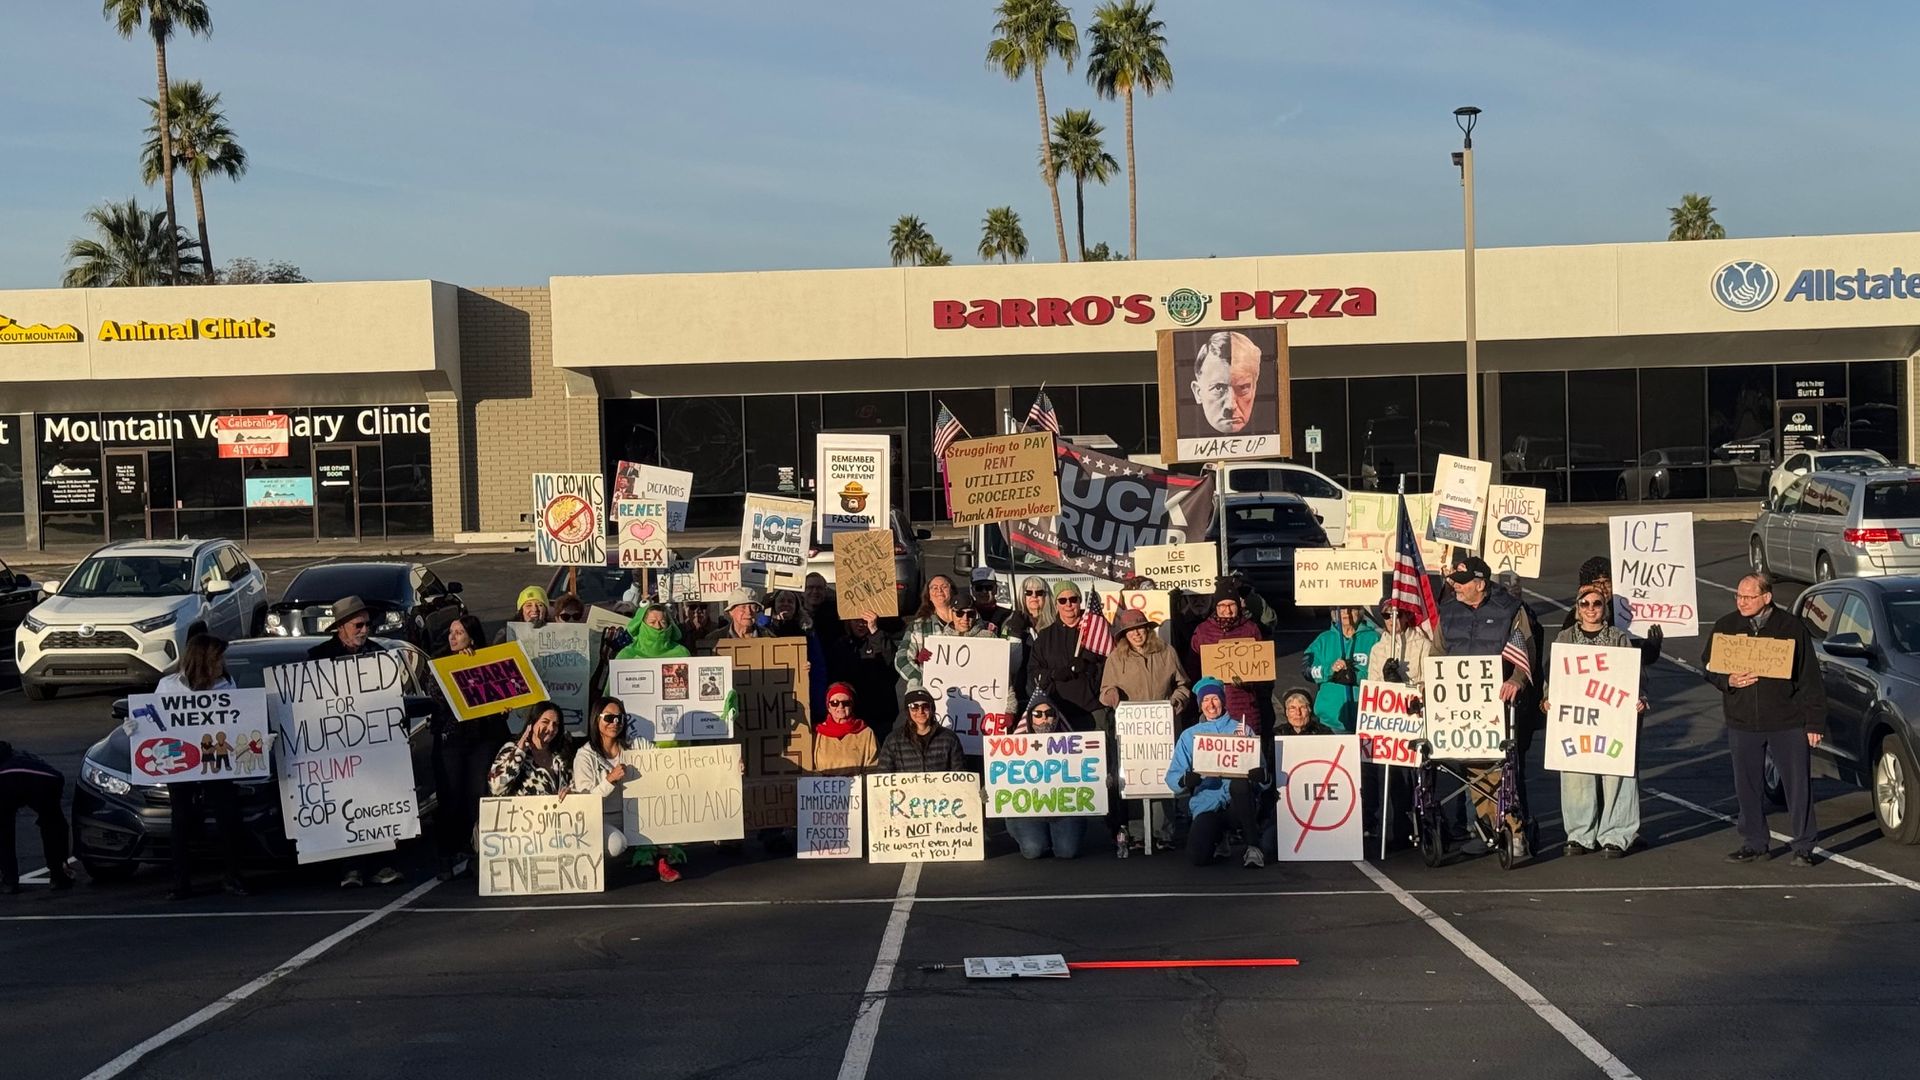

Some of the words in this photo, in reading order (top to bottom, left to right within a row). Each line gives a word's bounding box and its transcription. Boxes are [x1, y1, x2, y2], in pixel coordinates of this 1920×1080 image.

[1784, 267, 1920, 302] Allstate
[1220, 287, 1378, 321] PIZZA
[25, 332, 75, 341] MOUNTAIN
[98, 318, 198, 341] Animal
[199, 317, 276, 340] Clinic
[44, 413, 183, 443] Mountain
[358, 407, 430, 436] Clinic
[228, 417, 278, 429] Celebrating
[233, 446, 243, 454] 41
[246, 444, 275, 454] Years!
[947, 442, 1006, 459] Struggling
[1009, 441, 1020, 451] to
[1024, 436, 1048, 450] PAY
[1194, 439, 1241, 456] WAKE
[1245, 437, 1267, 454] UP
[832, 455, 875, 463] REMEMBER
[832, 464, 854, 472] ONLY
[856, 464, 875, 472] YOU
[984, 456, 1016, 470] RENT
[1453, 462, 1477, 472] Dissent
[965, 470, 1035, 488] UTILITIES
[535, 475, 554, 509] NO
[557, 475, 603, 507] CROWNS
[647, 482, 685, 498] DICTATORS
[968, 486, 1042, 505] GROCERIES
[1060, 462, 1188, 527] UCK
[1445, 494, 1472, 504] Patriotic
[1500, 487, 1525, 499] THIS
[619, 504, 662, 517] RENEE
[953, 508, 985, 524] Thank
[986, 508, 994, 518] A
[995, 506, 1027, 519] Trump
[1027, 503, 1056, 515] Voter
[1499, 499, 1535, 516] HOUSE
[752, 513, 803, 543] ICE
[832, 515, 875, 524] FASCISM
[1040, 505, 1187, 557] RUMP
[1624, 521, 1669, 552] ICE
[538, 529, 558, 563] NO
[560, 534, 606, 564] CLOWNS
[751, 542, 776, 551] MELTS
[777, 544, 800, 554] UNDER
[1018, 522, 1026, 531] If
[1027, 524, 1045, 539] You
[1047, 533, 1068, 549] Like
[1071, 543, 1102, 562] Trump
[1105, 555, 1132, 568] Fuck
[1493, 540, 1540, 557] CORRUPT
[622, 549, 663, 561] ALEX
[750, 551, 798, 564] RESISTANCE
[1167, 551, 1185, 560] ICE
[1499, 555, 1525, 571] AF
[700, 560, 740, 571] TRUTH
[1145, 564, 1201, 576] DOMESTIC
[1296, 562, 1319, 571] PRO
[1326, 561, 1377, 571] AMERICA
[1620, 559, 1685, 588] MUST
[710, 572, 731, 580] NOT
[1154, 578, 1212, 590] ERRORISTS
[1299, 579, 1329, 588] ANTI
[1339, 578, 1379, 588] TRUMP
[700, 582, 739, 593] TRUMP
[844, 571, 894, 606] POWER
[1631, 589, 1650, 599] BE
[682, 592, 701, 602] ICE
[1619, 600, 1693, 621] STOPPED
[539, 631, 587, 651] Liberty
[936, 644, 971, 668] NO
[1215, 643, 1264, 660] STOP
[1215, 660, 1270, 678] TRUMP
[1434, 660, 1493, 680] ICE
[1564, 653, 1609, 675] ICE
[272, 652, 399, 704] WANTED
[929, 678, 1004, 700] Secret
[1433, 683, 1494, 703] OUT
[1585, 679, 1630, 708] OUT
[161, 693, 231, 710] WHO'S
[326, 696, 355, 715] FOR
[1361, 685, 1416, 715] HON
[171, 710, 241, 727] NEXT?
[1118, 705, 1170, 720] PROTECT
[1451, 709, 1483, 720] FOR
[1559, 704, 1600, 726] FOR
[280, 706, 409, 756] MURDER
[1117, 721, 1172, 736] AMERICA
[1360, 713, 1424, 733] PEACEFULLY
[988, 737, 1028, 757] YOU
[1197, 737, 1255, 752] ABOLISH
[1433, 729, 1500, 749] GOOD
[1561, 734, 1624, 759] GOOD
[679, 748, 733, 771] literally
[1120, 742, 1174, 760] ELIMINATE
[293, 755, 363, 782] TRUMP
[990, 757, 1100, 784] PEOPLE
[1217, 755, 1239, 768] ICE
[666, 773, 691, 790] on
[873, 775, 897, 788] ICE
[901, 775, 918, 784] out
[922, 775, 938, 785] for
[942, 773, 976, 784] GOOD
[1126, 769, 1166, 786] ICE
[298, 781, 336, 807] ICE
[813, 780, 846, 794] KEEP
[1304, 783, 1339, 801] ICE
[800, 795, 860, 810] IMMIGRANTS
[889, 789, 967, 819] Renee
[995, 786, 1096, 813] POWER
[298, 803, 337, 828] GOP
[342, 799, 411, 822] CONGRESS
[481, 799, 534, 834] It's
[812, 811, 850, 826] DEPORT
[346, 820, 402, 843] SENATE
[548, 823, 591, 850] dick
[806, 828, 851, 840] FASCIST
[884, 825, 901, 838] it's
[906, 822, 932, 837] NOT
[810, 840, 851, 856] NAZIS
[872, 841, 890, 853] she
[928, 840, 950, 848] even
[911, 849, 925, 859] at
[489, 853, 603, 894] ENERGY
